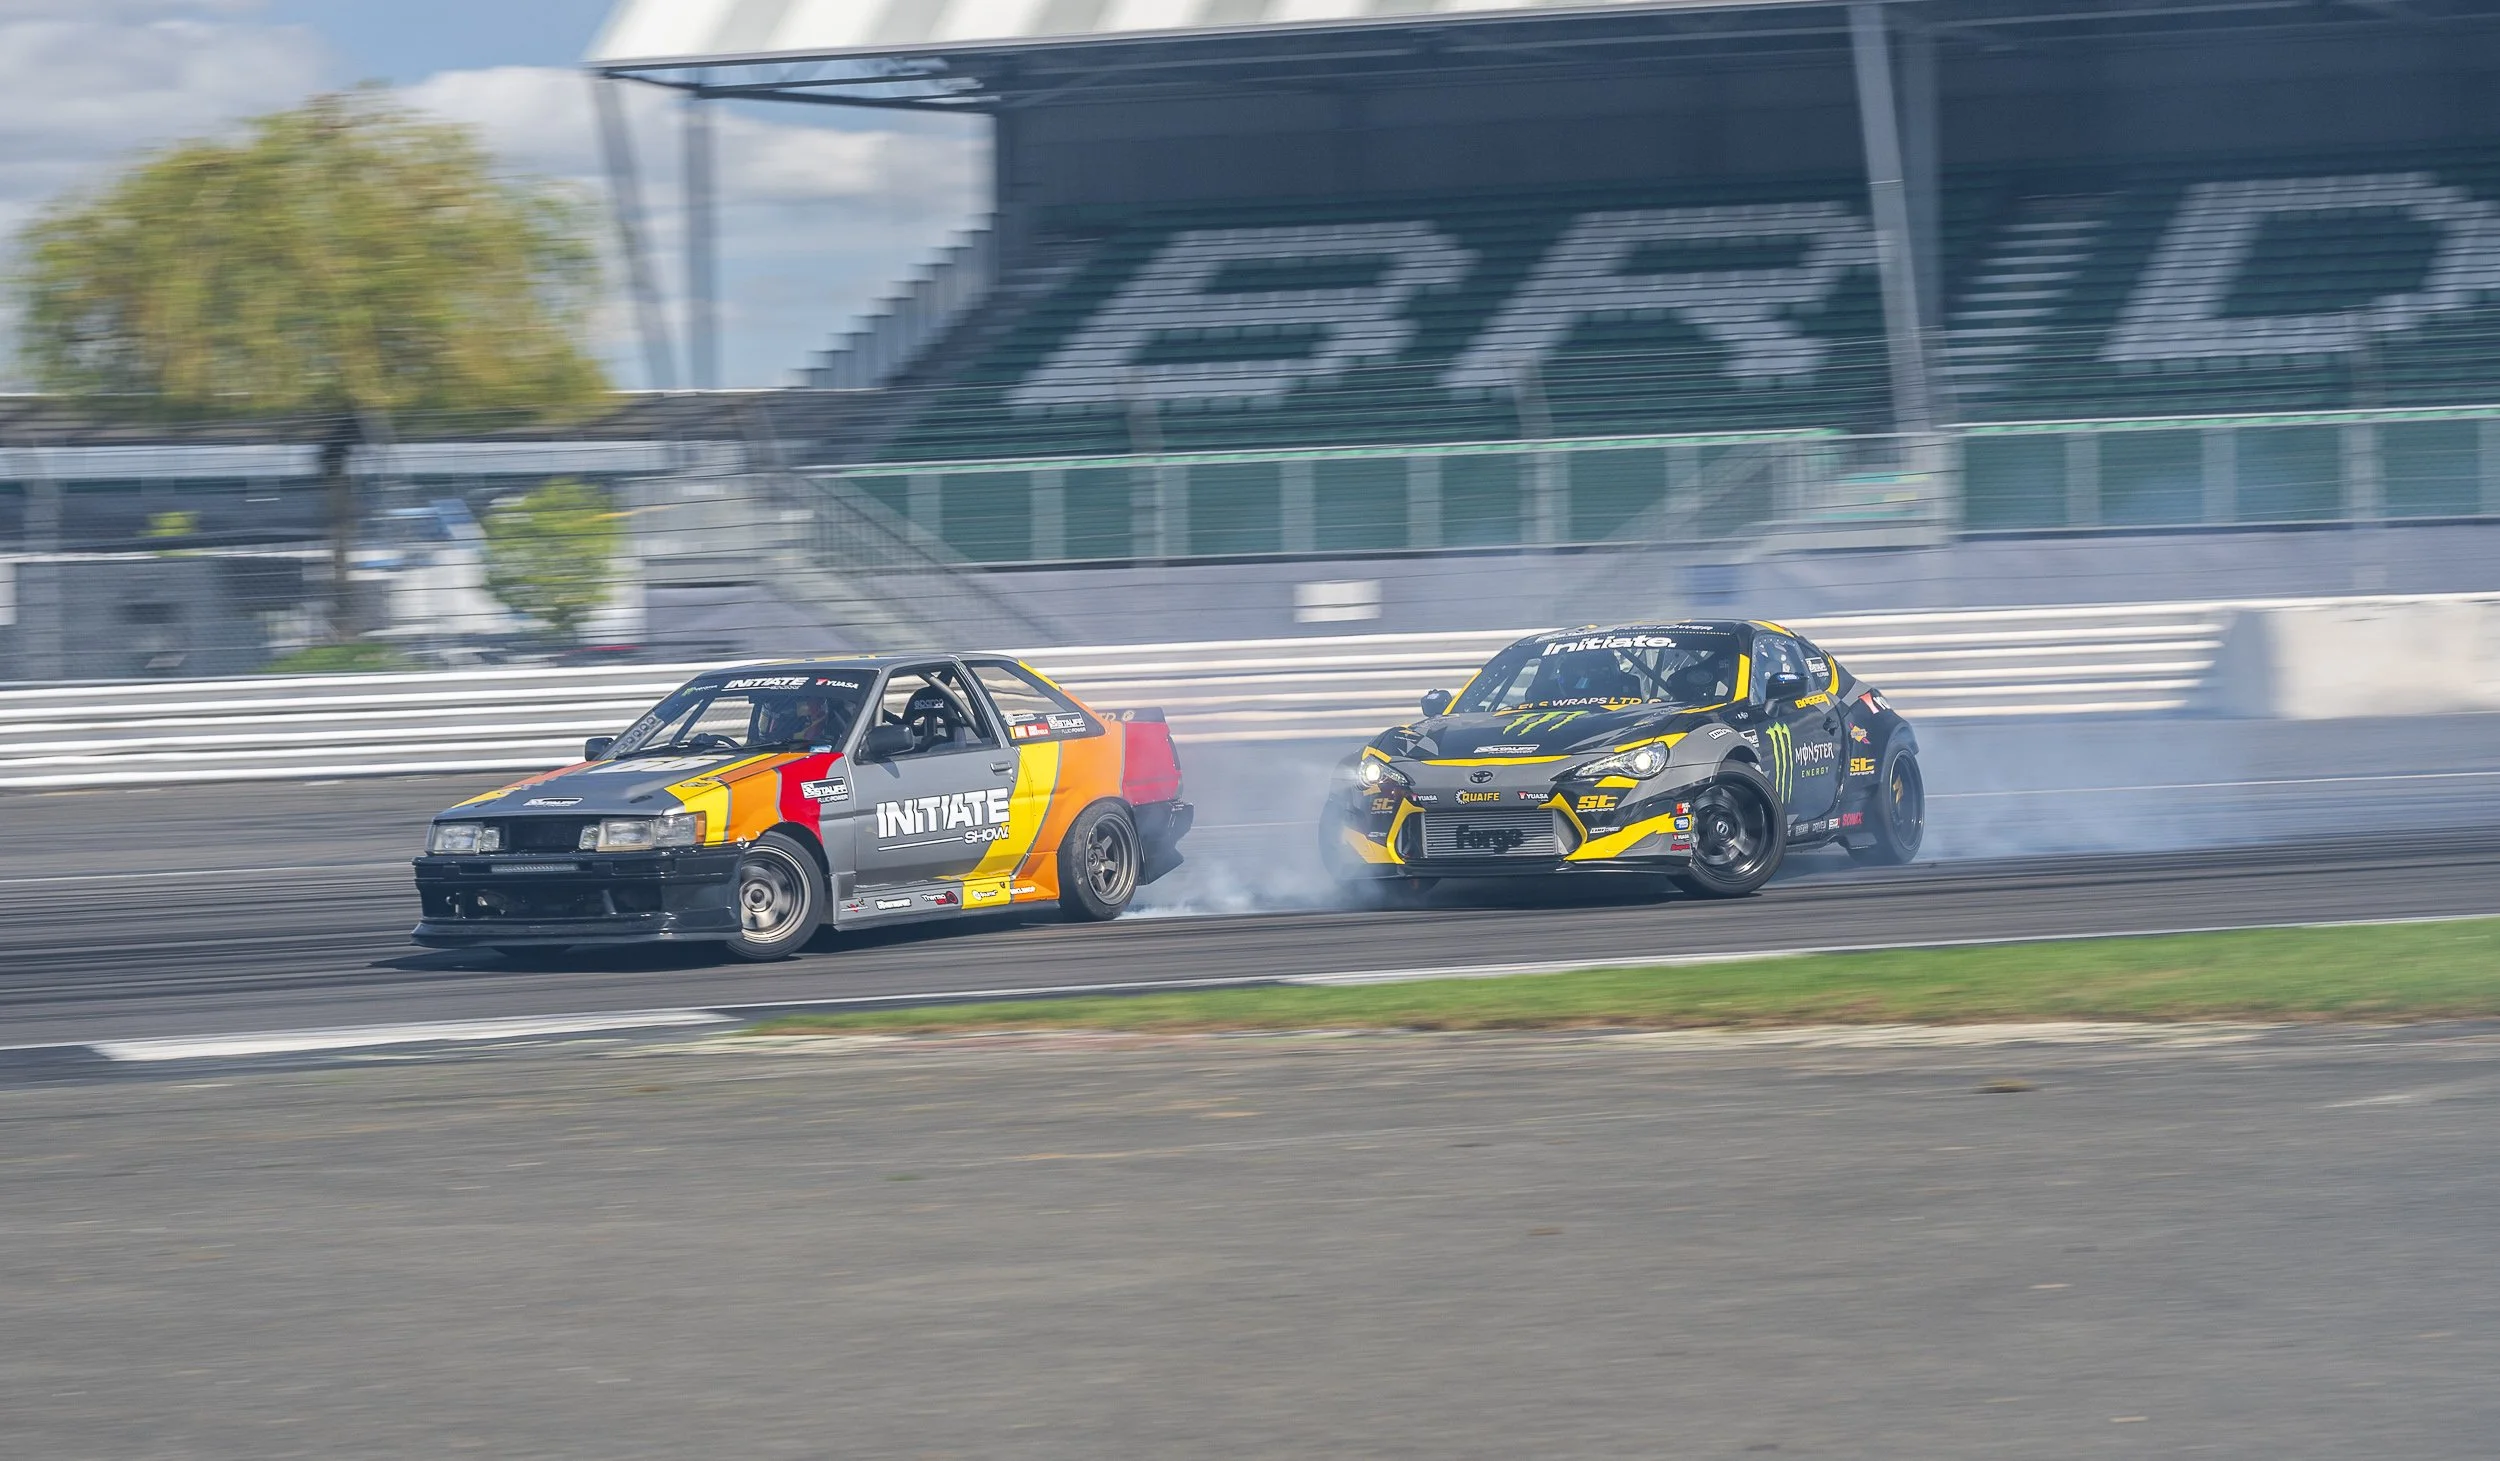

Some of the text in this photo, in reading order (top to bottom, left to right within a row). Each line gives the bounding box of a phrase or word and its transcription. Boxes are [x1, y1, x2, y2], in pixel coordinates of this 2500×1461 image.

[725, 677, 809, 688] INITIATE
[826, 680, 859, 689] YUASA
[1552, 696, 1608, 707] WRAPS
[1609, 696, 1642, 705] LTD
[1058, 718, 1085, 728] STAUFF
[1802, 767, 1829, 778] ENERGY
[813, 785, 848, 796] STAUFF
[1462, 791, 1500, 802] QUAIFE
[876, 787, 1010, 839] INITIATE
